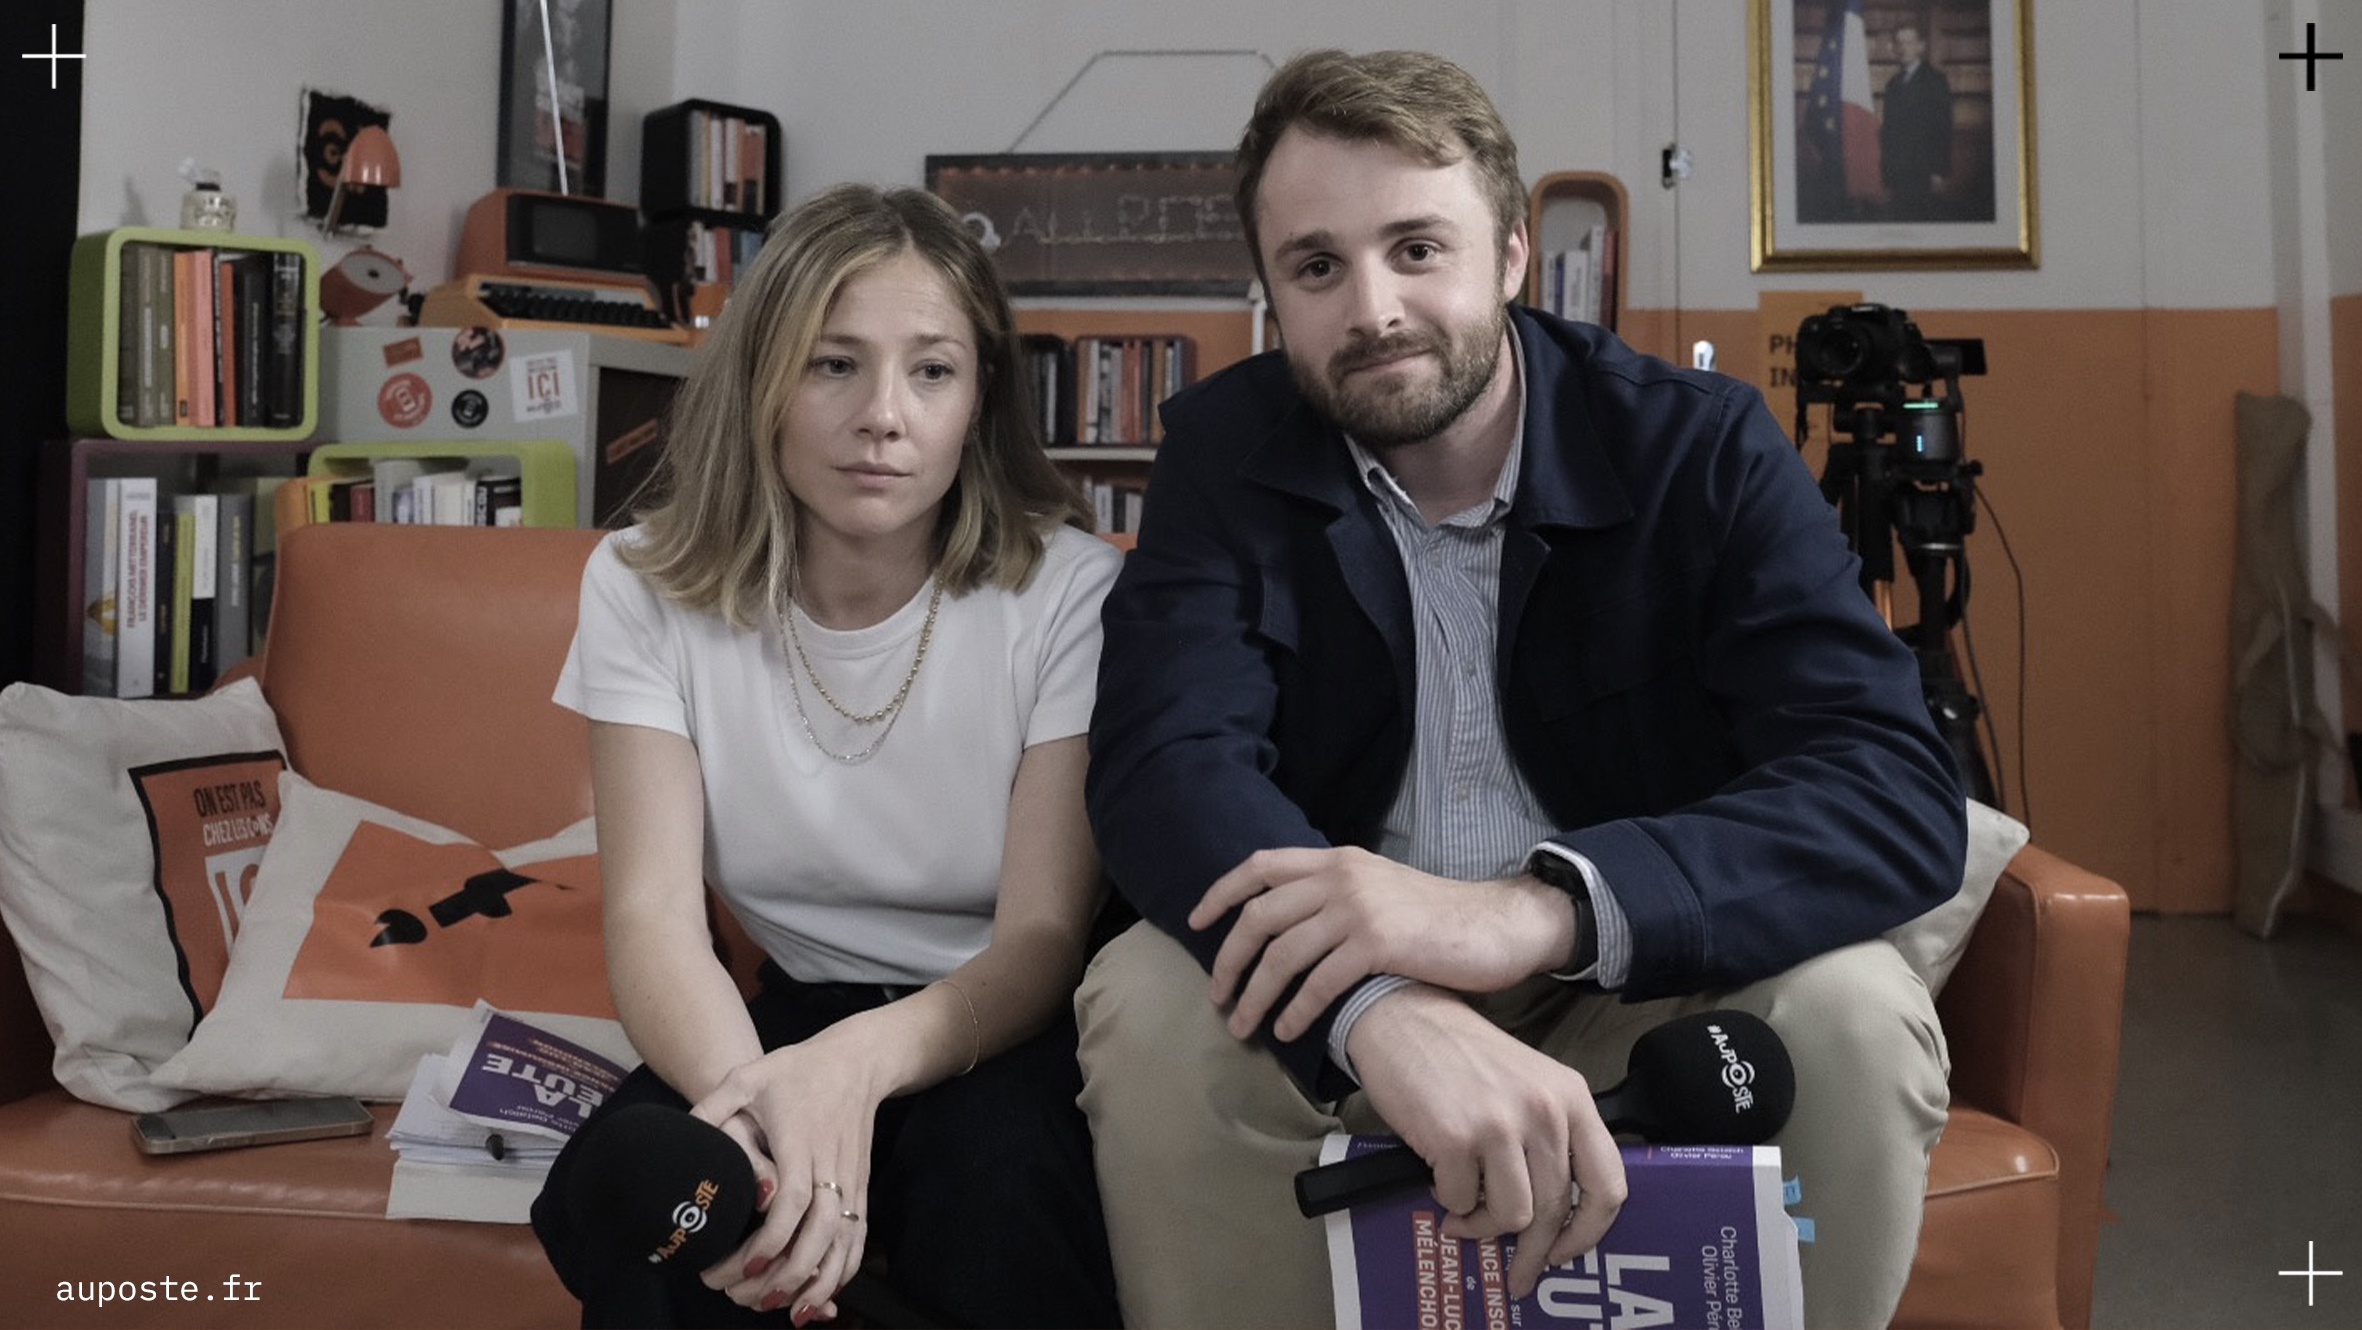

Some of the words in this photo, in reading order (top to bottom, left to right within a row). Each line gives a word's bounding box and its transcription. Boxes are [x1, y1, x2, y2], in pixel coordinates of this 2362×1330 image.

[527, 371, 560, 399] ICI
[193, 787, 218, 817] ON
[215, 783, 240, 814] EST
[240, 780, 266, 811] PAS
[203, 820, 234, 847] CHEZ
[533, 1084, 593, 1119] LA
[1415, 1219, 1438, 1330] MÉLENCHO
[1701, 1245, 1721, 1297] Olivier
[1720, 1226, 1740, 1304] Charlotte
[1466, 1275, 1476, 1291] de
[1605, 1253, 1675, 1330] LA
[1510, 1304, 1522, 1327] sur
[1706, 1300, 1724, 1330] Pér
